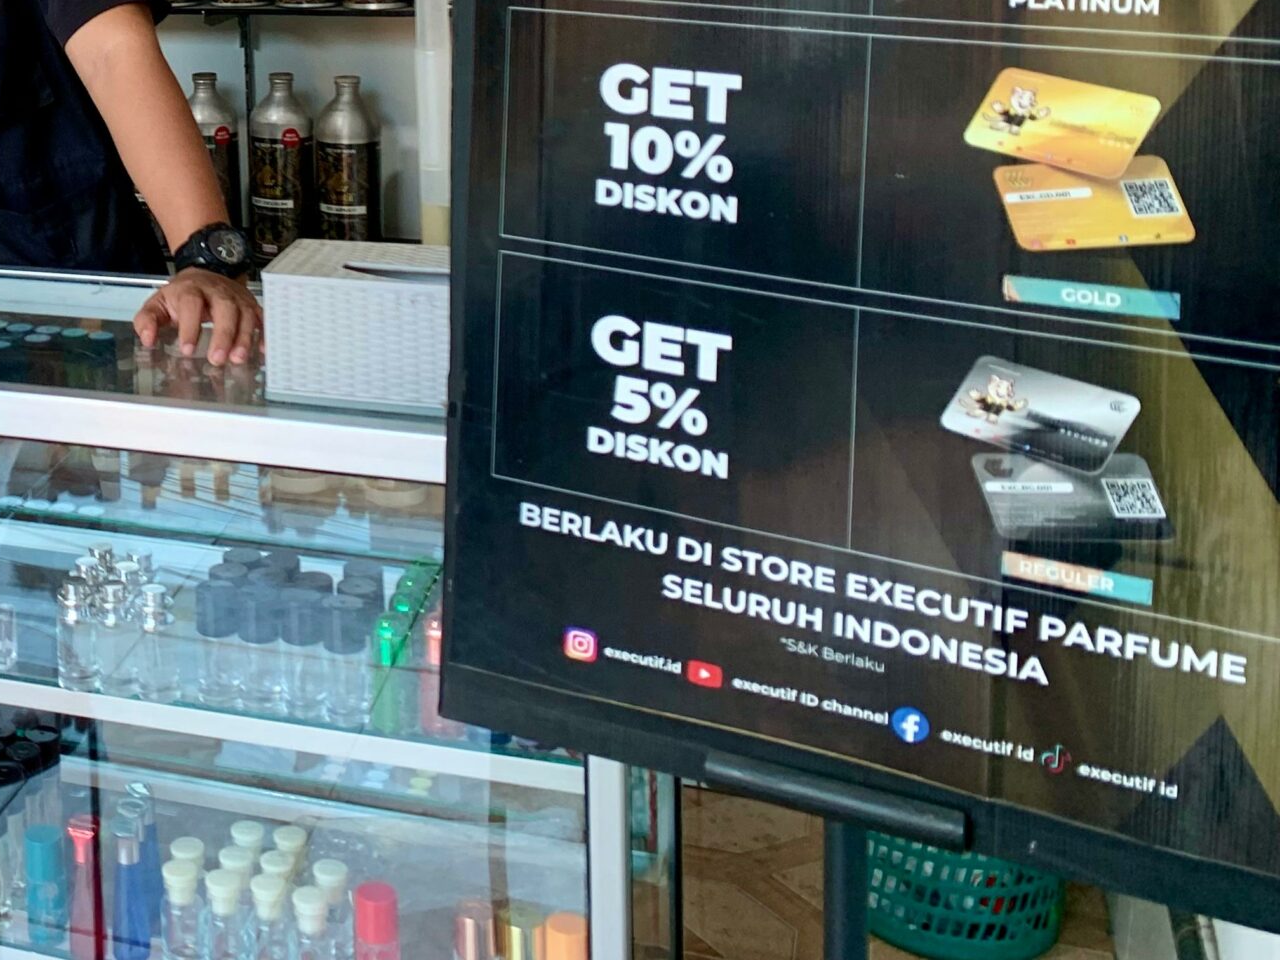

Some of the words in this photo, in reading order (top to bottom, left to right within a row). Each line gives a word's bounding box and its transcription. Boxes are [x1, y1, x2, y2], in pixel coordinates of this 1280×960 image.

[599, 63, 742, 124] GET
[604, 126, 733, 184] 10%
[595, 177, 739, 224] DISKON
[1061, 287, 1122, 308] GOLD
[591, 314, 732, 381] GET
[609, 375, 708, 436] 5%
[586, 426, 729, 479] DISKON
[520, 501, 669, 556] BERLAKU
[677, 535, 713, 567] DI
[721, 545, 837, 594] STORE
[846, 572, 1030, 635] EXECUTIF
[1040, 613, 1250, 685] PARFUME
[1019, 559, 1115, 593] REGULER
[662, 574, 824, 632] SELURUH
[833, 610, 1050, 687] INDONESIA
[603, 646, 683, 676] executif.id
[823, 646, 887, 674] Berlaku
[731, 676, 799, 703] executif
[800, 692, 820, 708] ID
[821, 697, 891, 726] channel
[940, 728, 1015, 756] executif
[1017, 745, 1035, 763] id
[1076, 763, 1157, 794] executif
[1160, 780, 1180, 800] id
